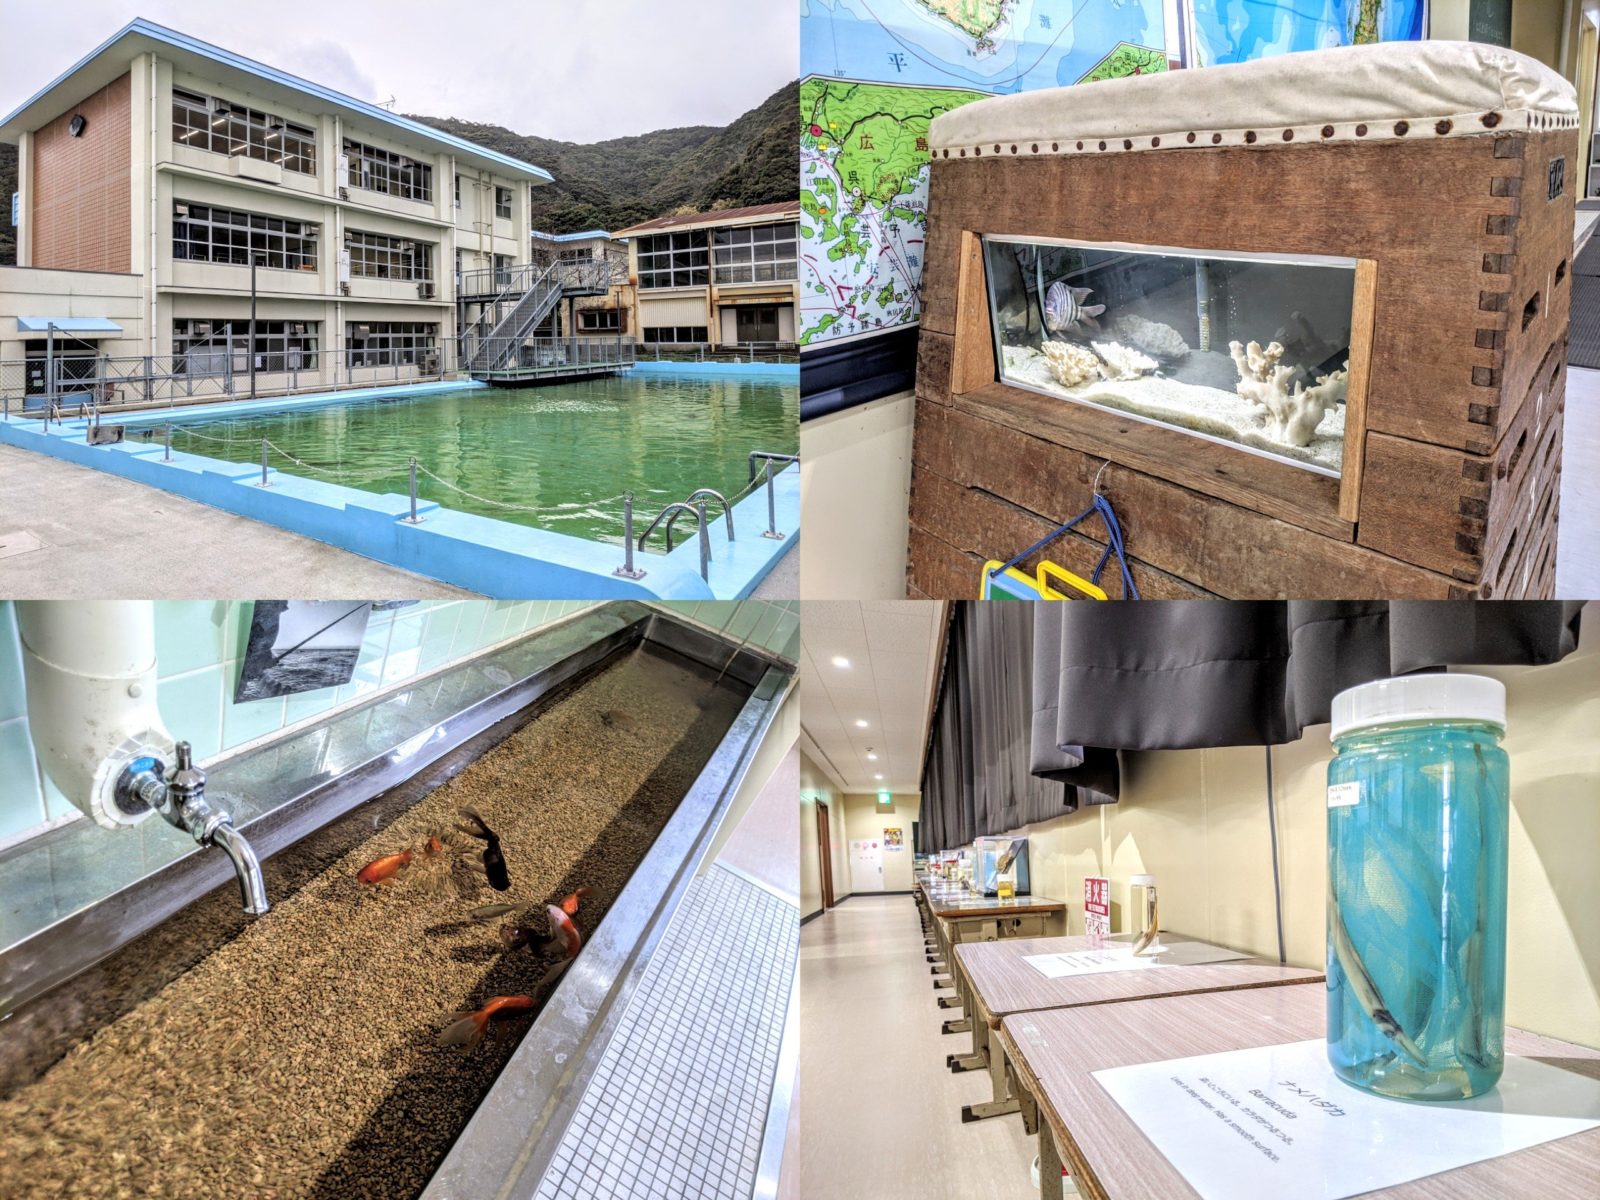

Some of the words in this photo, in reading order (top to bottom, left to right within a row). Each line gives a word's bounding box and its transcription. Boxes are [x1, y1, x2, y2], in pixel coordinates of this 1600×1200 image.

[887, 52, 907, 73] 平
[848, 170, 860, 186] 呉
[1248, 1088, 1298, 1120] Barracuda
[1277, 1080, 1347, 1117] ナメハダカ
[1228, 1122, 1255, 1142] smooth
